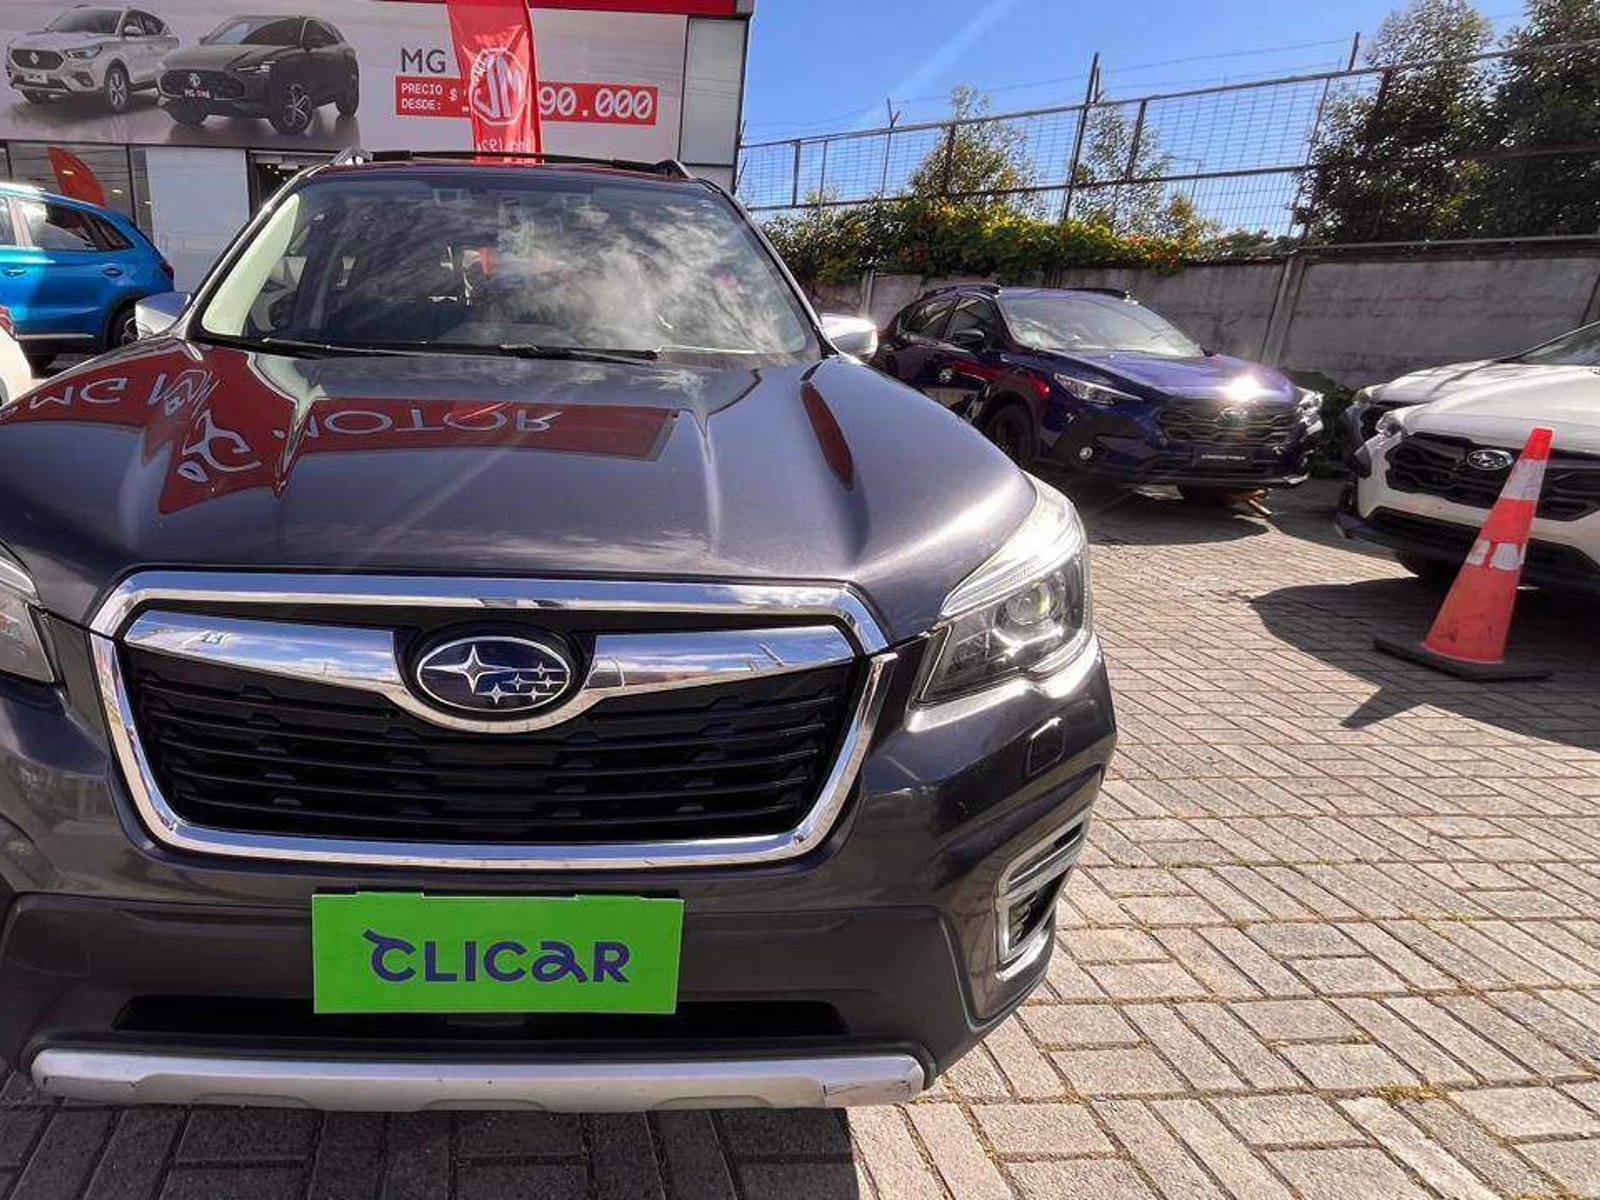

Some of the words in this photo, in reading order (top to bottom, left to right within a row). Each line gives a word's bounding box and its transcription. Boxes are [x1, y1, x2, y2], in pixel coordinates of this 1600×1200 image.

[401, 48, 446, 73] MG
[401, 83, 443, 96] PRECIO
[401, 98, 441, 110] DESDE:
[540, 86, 653, 119] 90.000
